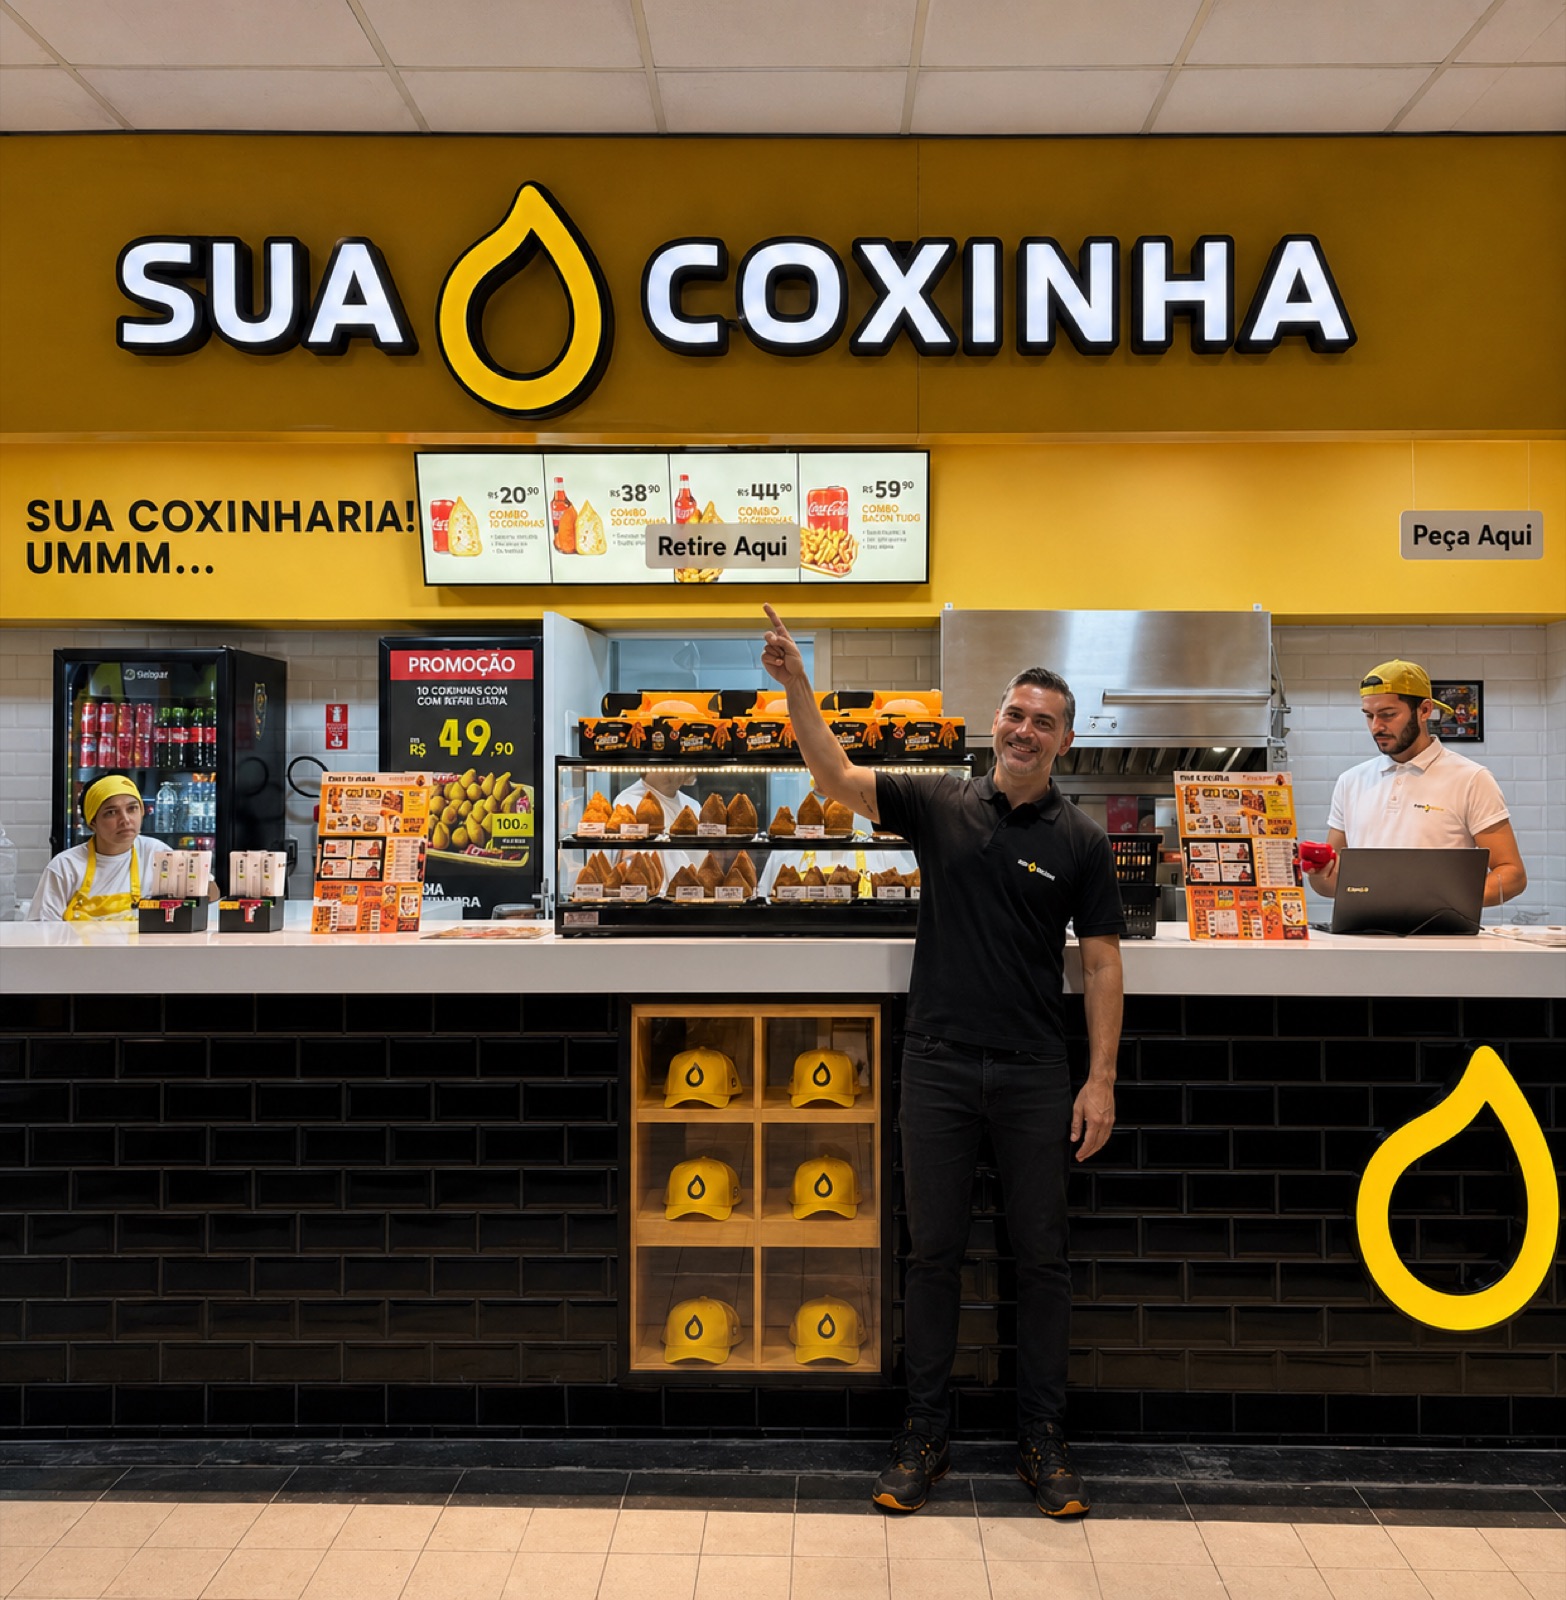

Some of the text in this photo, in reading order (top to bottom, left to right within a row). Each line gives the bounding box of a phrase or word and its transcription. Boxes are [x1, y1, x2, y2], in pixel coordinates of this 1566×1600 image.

[119, 237, 1355, 351] SUA COXINHA
[26, 499, 416, 533] SUA COXINHARIA!
[861, 504, 899, 514] COMBO
[658, 535, 727, 556] Retire
[733, 535, 788, 562] Aqui
[1413, 523, 1533, 551] Peça Aqui
[26, 541, 214, 574] UMMM...
[408, 653, 516, 677] PROMOÇÃO
[416, 686, 429, 695] 10
[484, 686, 508, 695] COM
[417, 696, 441, 706] COM
[409, 743, 427, 758] R$
